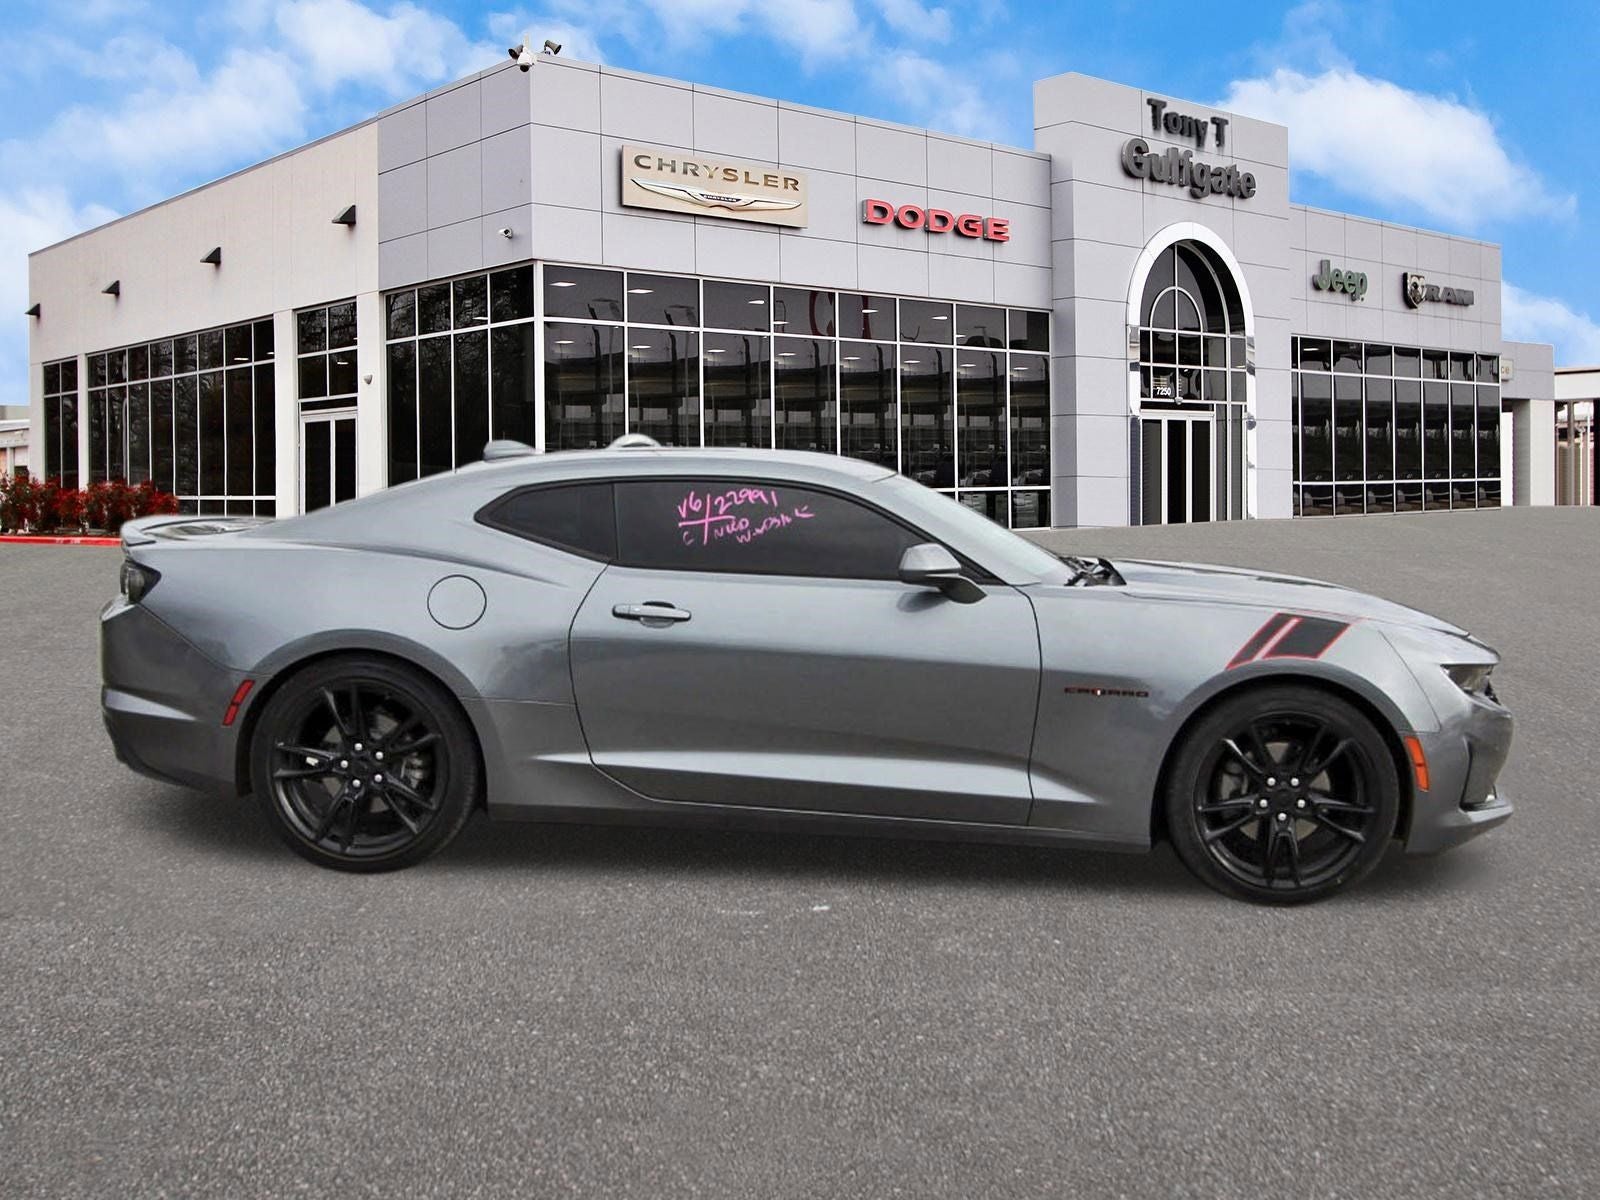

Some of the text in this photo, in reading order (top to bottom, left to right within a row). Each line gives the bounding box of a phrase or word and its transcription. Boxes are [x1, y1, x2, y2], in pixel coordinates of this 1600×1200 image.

[1147, 98, 1229, 147] Tony T
[634, 154, 800, 191] CHRYSLER
[1121, 138, 1256, 199] Gulfgate
[863, 199, 1010, 242] DODGE
[1312, 259, 1368, 301] Jeep
[1424, 284, 1474, 306] RAM
[1156, 387, 1172, 396] 7250
